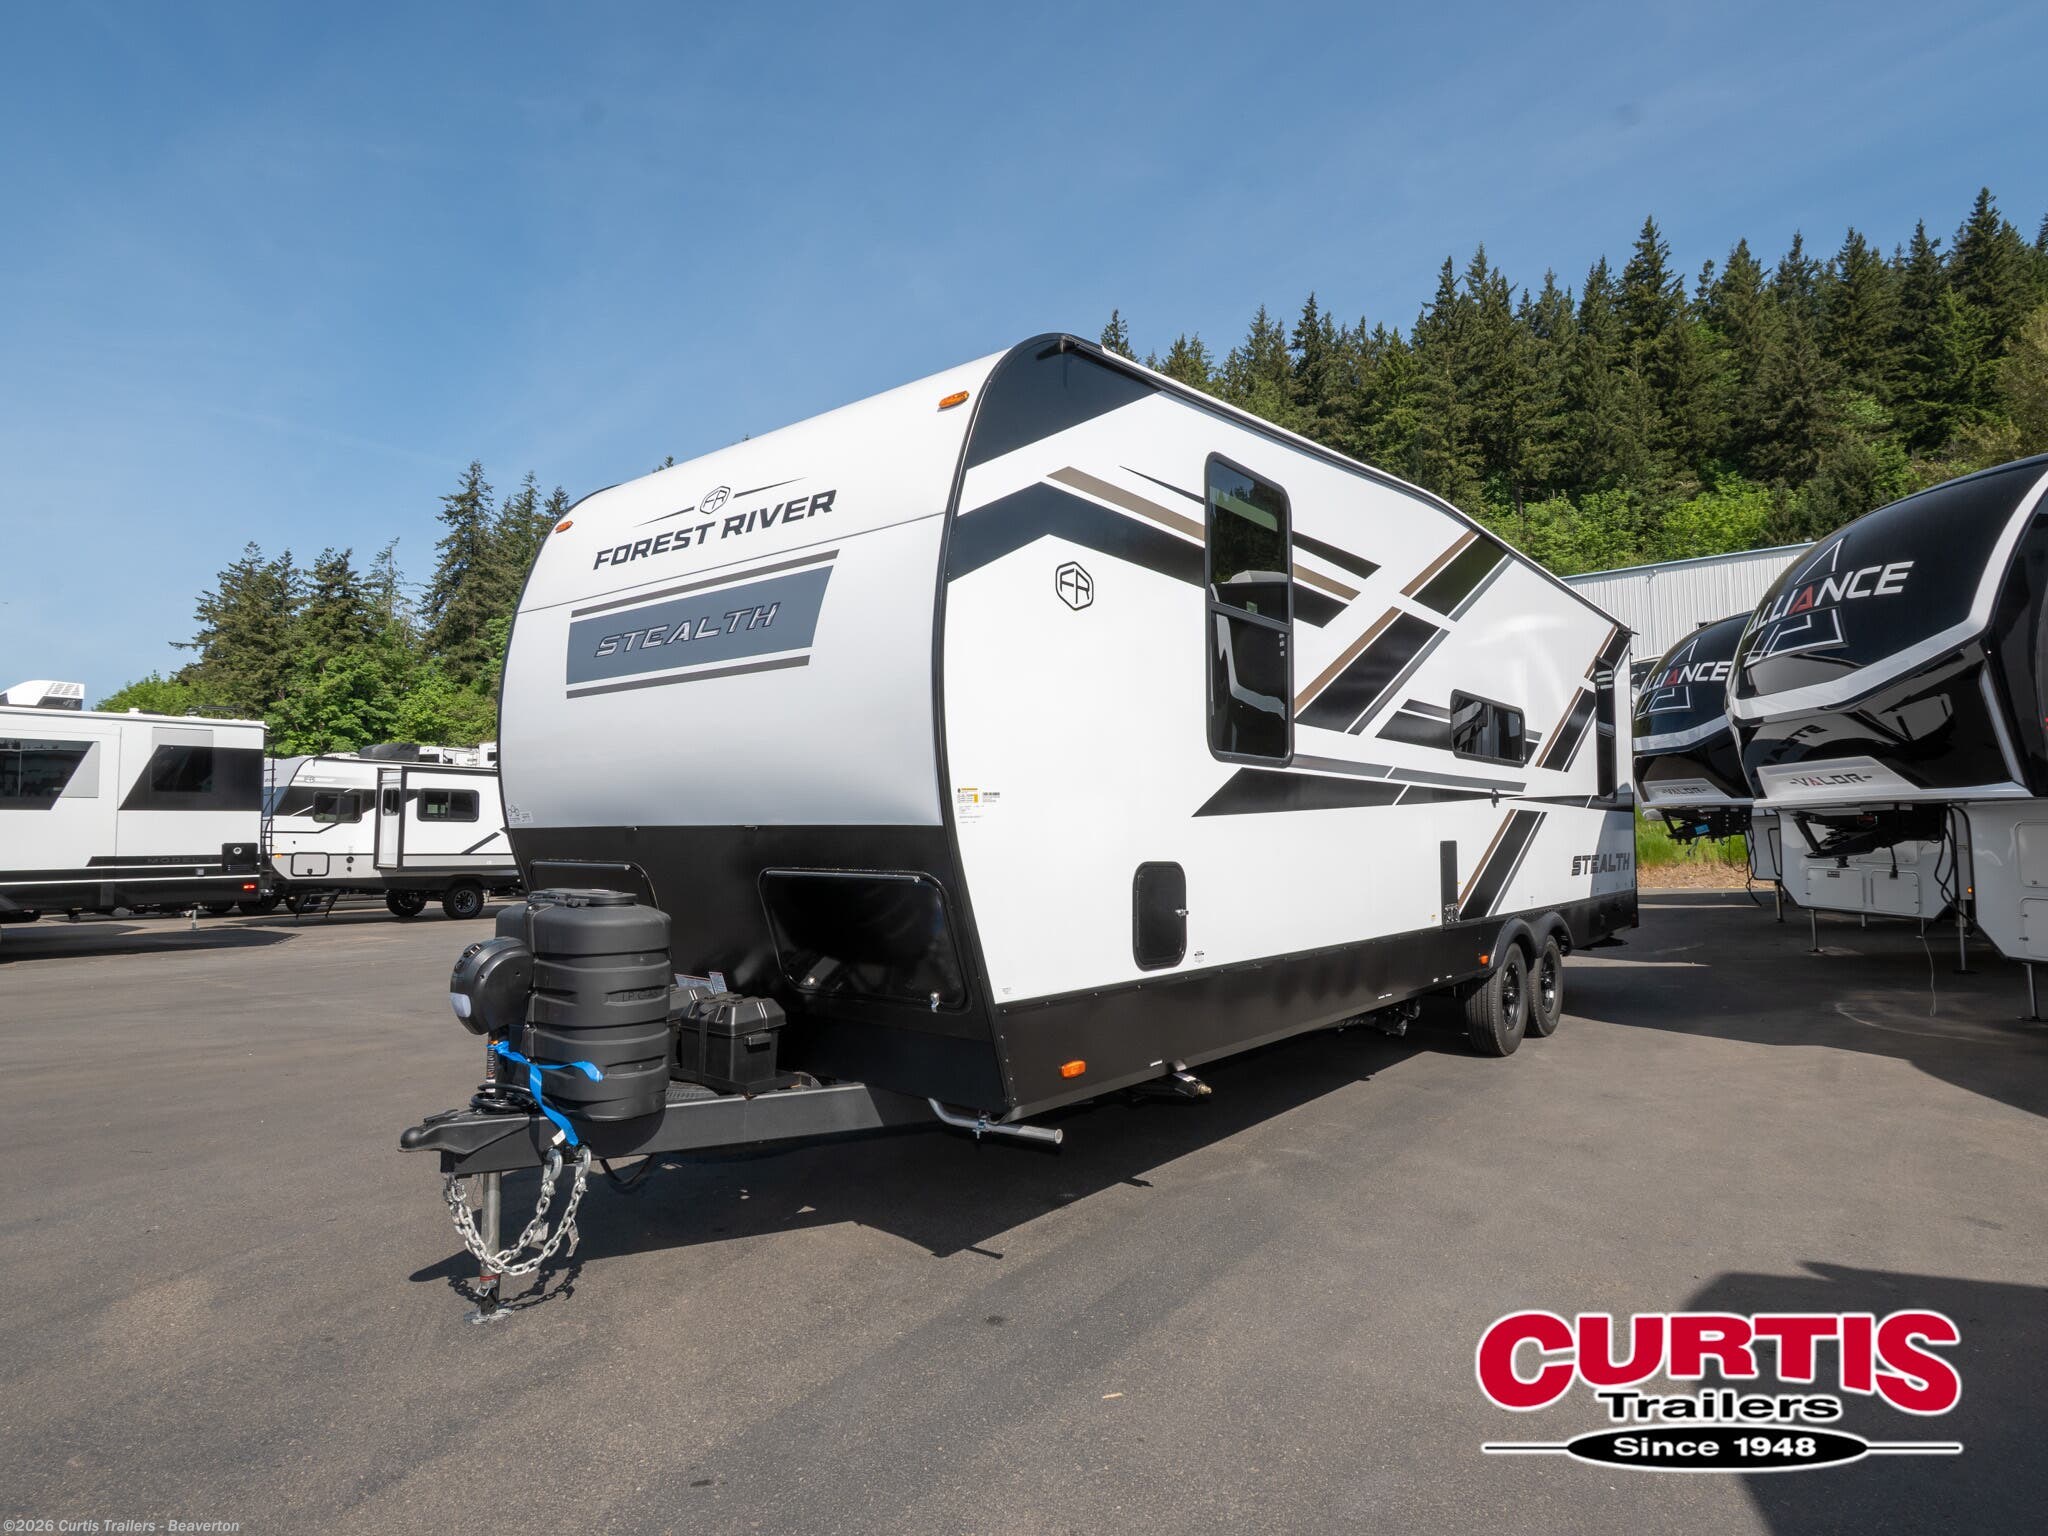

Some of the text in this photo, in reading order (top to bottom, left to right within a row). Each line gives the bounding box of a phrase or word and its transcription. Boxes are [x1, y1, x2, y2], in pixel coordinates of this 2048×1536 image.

[593, 489, 838, 570] FOREST RIVER
[594, 602, 781, 658] STEALTH
[1744, 560, 1916, 640] ALLIANCE
[1571, 852, 1631, 877] STEALTH
